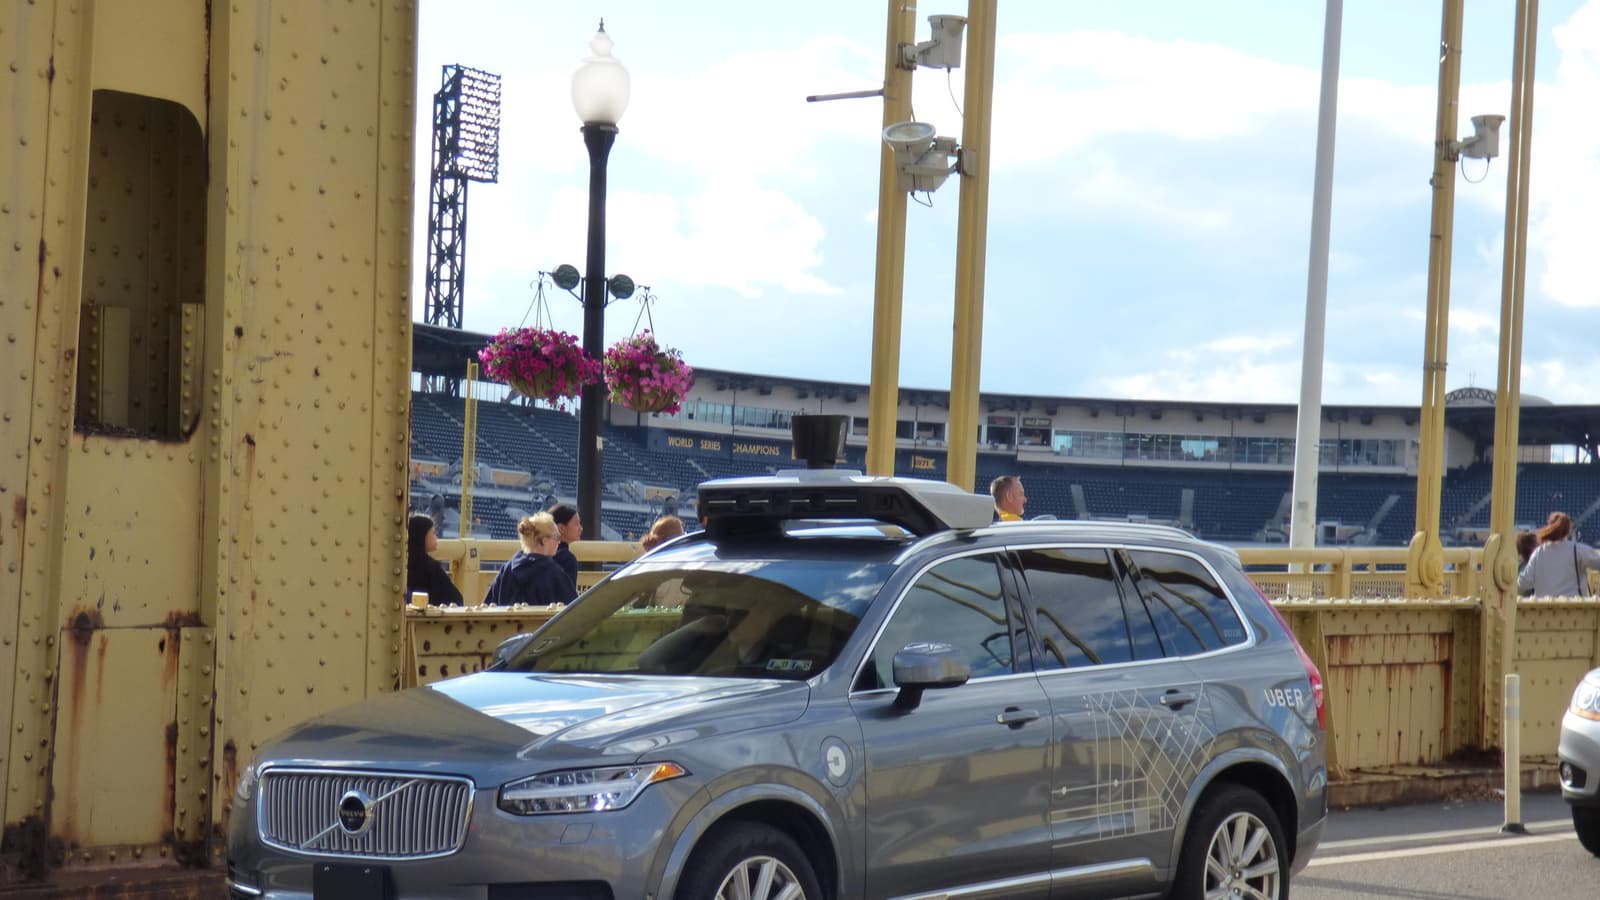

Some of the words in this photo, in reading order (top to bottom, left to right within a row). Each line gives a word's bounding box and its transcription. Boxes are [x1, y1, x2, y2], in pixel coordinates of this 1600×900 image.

[667, 436, 694, 448] WORLD
[700, 439, 720, 451] SERIES
[732, 442, 780, 456] CHAMPIONS
[1263, 688, 1304, 708] UBER
